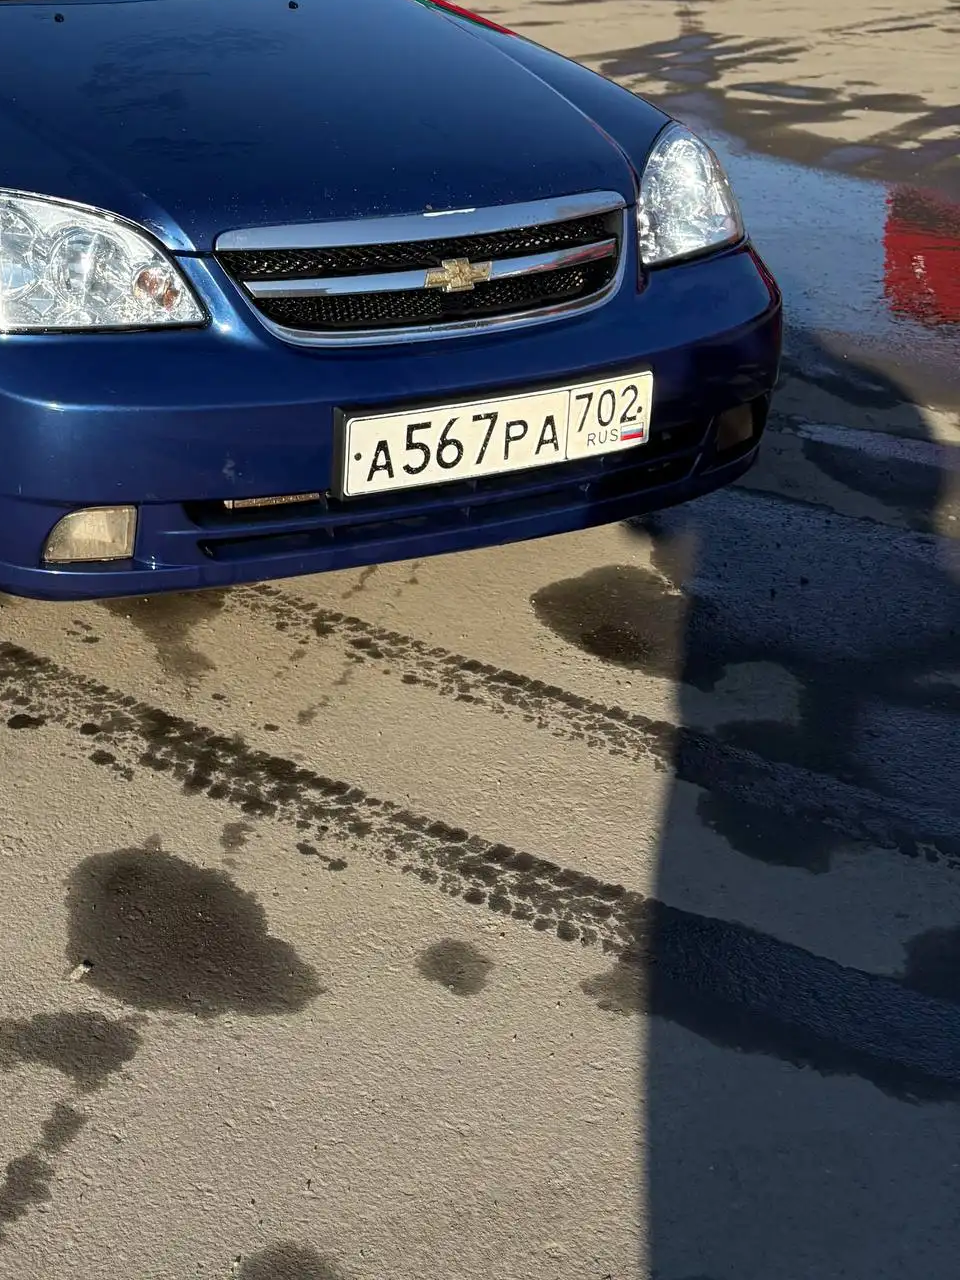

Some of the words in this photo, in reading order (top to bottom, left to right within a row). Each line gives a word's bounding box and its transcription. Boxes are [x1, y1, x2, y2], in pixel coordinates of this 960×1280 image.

[366, 411, 560, 482] А567РА
[575, 384, 640, 433] 702
[587, 428, 619, 446] RUS
